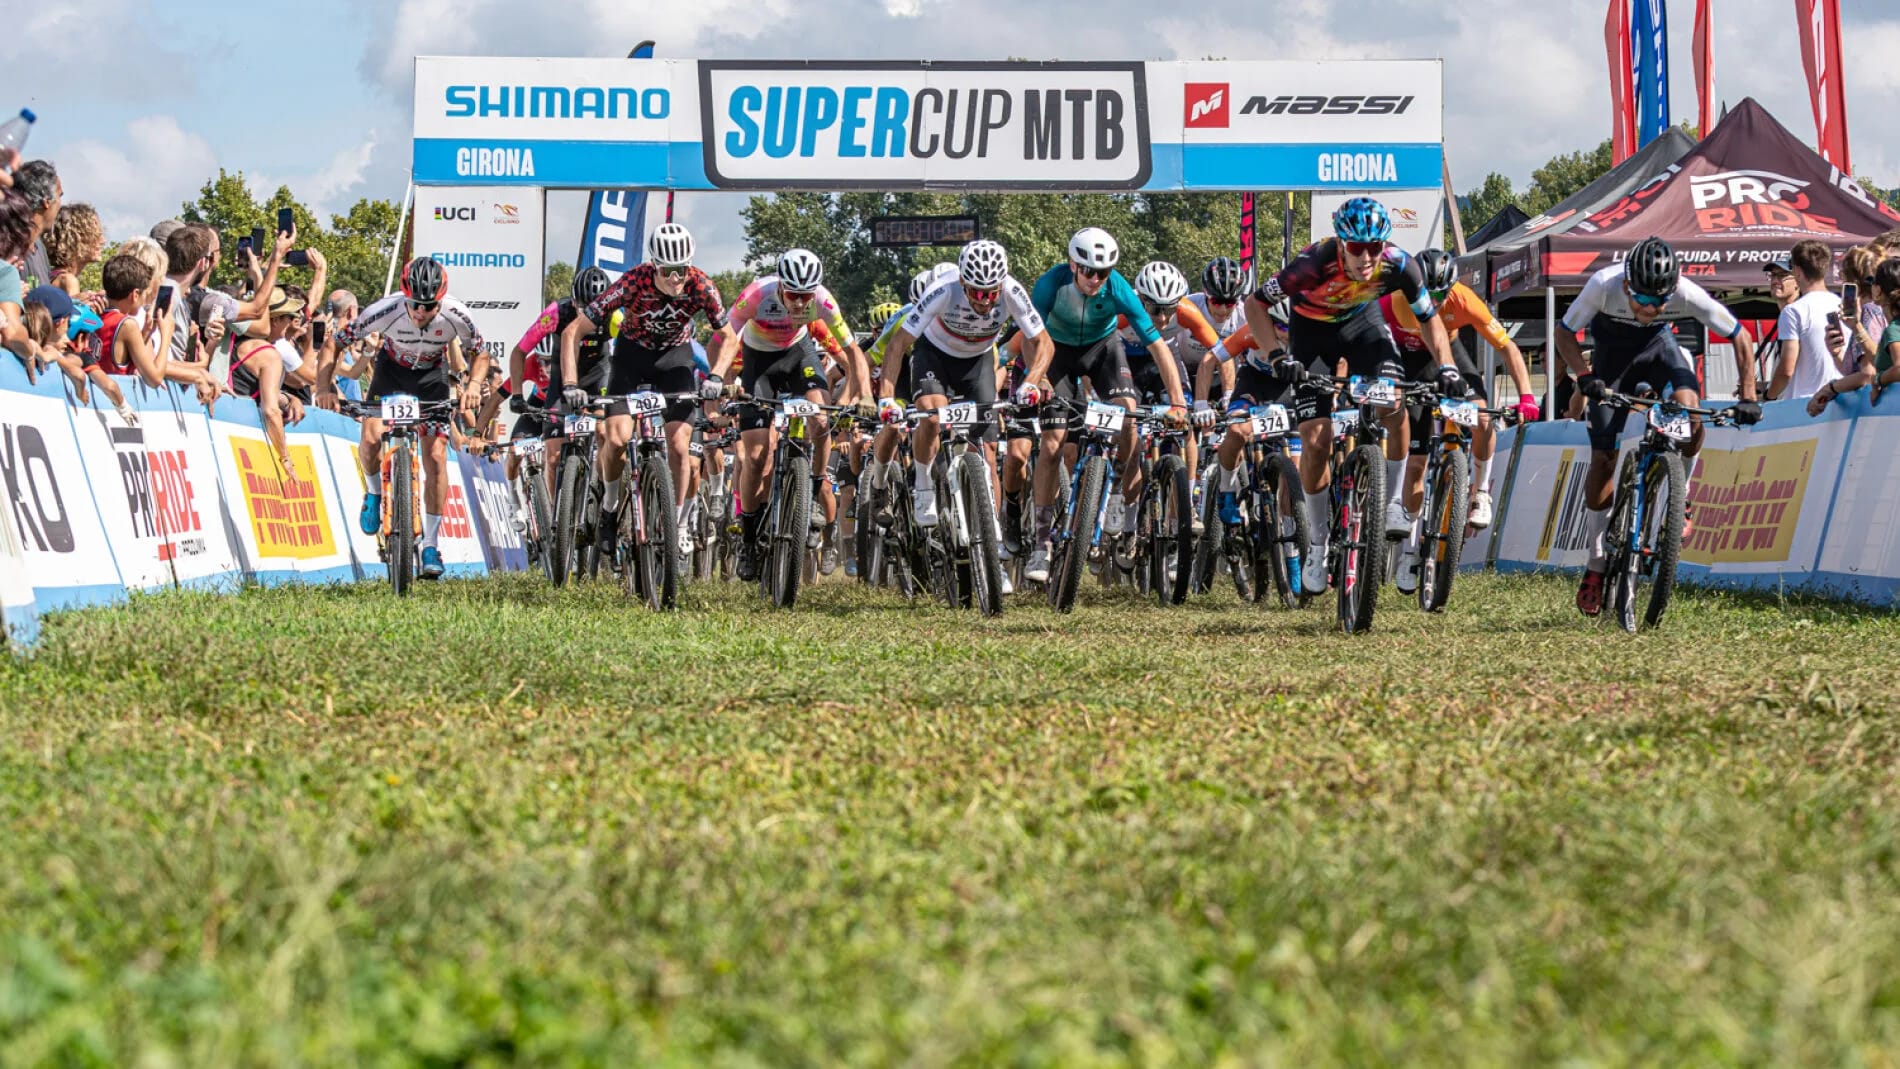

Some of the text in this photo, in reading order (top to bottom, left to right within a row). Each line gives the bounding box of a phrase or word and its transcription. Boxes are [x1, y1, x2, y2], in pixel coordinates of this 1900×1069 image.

[445, 85, 670, 120] SHIMANO
[725, 85, 1125, 161] SUPERCUP MTB
[457, 147, 534, 177] GIRONA
[1318, 152, 1398, 183] GIRONA
[1691, 176, 1810, 210] PRO
[442, 207, 476, 221] UCI
[1696, 203, 1840, 234] RIDE
[431, 252, 525, 268] SHIMANO
[1675, 250, 1792, 263] CUIDA Y PROTE
[1680, 264, 1716, 276] LETA
[389, 405, 414, 419] 132
[792, 405, 814, 414] 163
[946, 408, 970, 422] 397
[571, 421, 590, 432] 161
[1097, 413, 1115, 427] 17
[1259, 416, 1284, 432] 374
